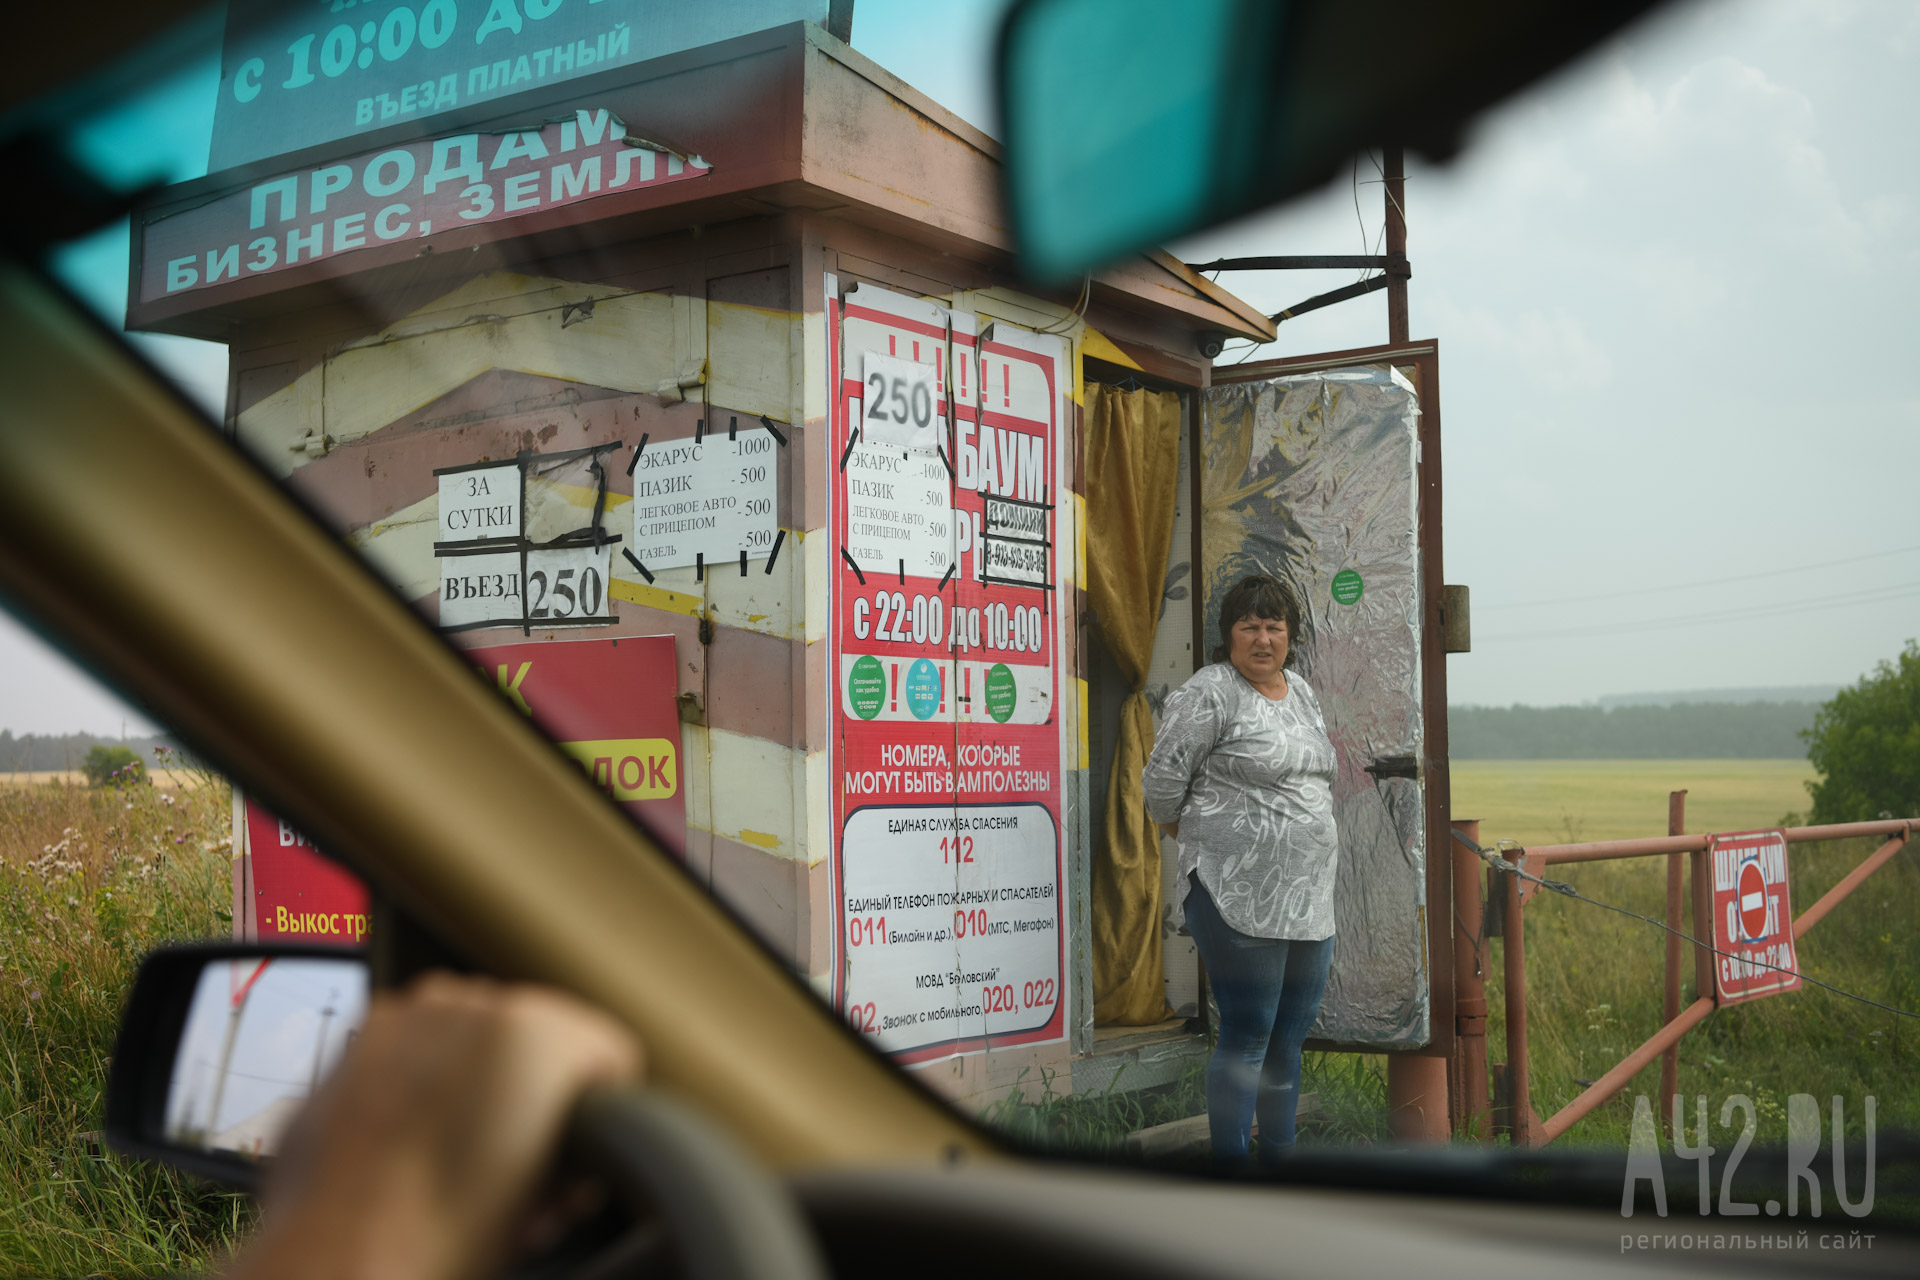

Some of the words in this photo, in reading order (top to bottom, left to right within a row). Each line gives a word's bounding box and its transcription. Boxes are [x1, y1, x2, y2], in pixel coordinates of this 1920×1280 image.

[282, 0, 458, 90] 10:00
[356, 72, 458, 128] ВЪЕЗД
[467, 21, 631, 97] ПЛАТНЫЙ
[250, 108, 627, 231] ПРОДАМ
[166, 202, 432, 293] БИЗНЕС,
[867, 371, 933, 429] 250
[640, 445, 703, 470] ЭКАРУС
[851, 451, 902, 474] ЭКАРУС
[467, 475, 492, 498] ЗА
[639, 475, 693, 498] ПАЗИК
[852, 478, 894, 501] ПАЗИК
[447, 504, 513, 530] СУТКИ
[639, 500, 700, 520] ЛЕГКОВОЕ
[702, 495, 737, 512] АВТО
[852, 505, 900, 523] ЛЕГКОВОЕ
[901, 513, 924, 527] АВТО
[639, 524, 648, 537] С
[650, 516, 716, 536] ПРИЦЕПОМ
[852, 522, 860, 536] С
[861, 522, 911, 541] ПРИЦЕПОМ
[639, 544, 677, 560] ГАЗЕЛЬ
[852, 546, 884, 561] ГАЗЕЛЬ
[444, 572, 521, 603] ВЪЕЗД
[528, 566, 603, 619] 250
[875, 589, 944, 645] 22:00
[983, 601, 1042, 653] 10:00
[881, 744, 951, 770] НОМЕРА,
[957, 744, 1021, 767] КОТОРЫЕ
[574, 755, 671, 799] ДОК
[846, 771, 901, 794] МОГУТ
[904, 771, 942, 793] БЫТЬ
[945, 771, 981, 793] ВАМ
[983, 770, 1050, 792] ПОЛЕЗНЫ
[888, 818, 927, 835] ЕДИНАЯ
[928, 817, 970, 833] СЛУЖБА
[972, 816, 1018, 831] СПАСЕНИЯ
[939, 835, 974, 864] 112
[1714, 843, 1786, 892] ШЛАУМ
[848, 894, 892, 913] ЕДИНЫЙ
[893, 892, 936, 911] ТЕЛЕФОН
[937, 889, 990, 906] ПОЖАРНЫХ
[991, 889, 999, 902] И
[1000, 883, 1054, 901] СПАСАТЕЛЕЙ
[276, 905, 341, 935] Выкос
[850, 916, 887, 947] 011
[888, 929, 925, 945] (Билайн
[926, 932, 933, 941] и
[954, 908, 987, 939] 010
[987, 919, 1012, 937] (МТС,
[1013, 917, 1055, 935] Мегафон)
[1728, 949, 1754, 981] 10:00
[1767, 942, 1792, 973] 22:00
[915, 974, 944, 989] МОВД
[882, 1014, 918, 1031] Звонок
[919, 1012, 926, 1023] с
[927, 1005, 983, 1022] мобильного,
[983, 983, 1019, 1015] 020,
[1023, 977, 1055, 1009] 022
